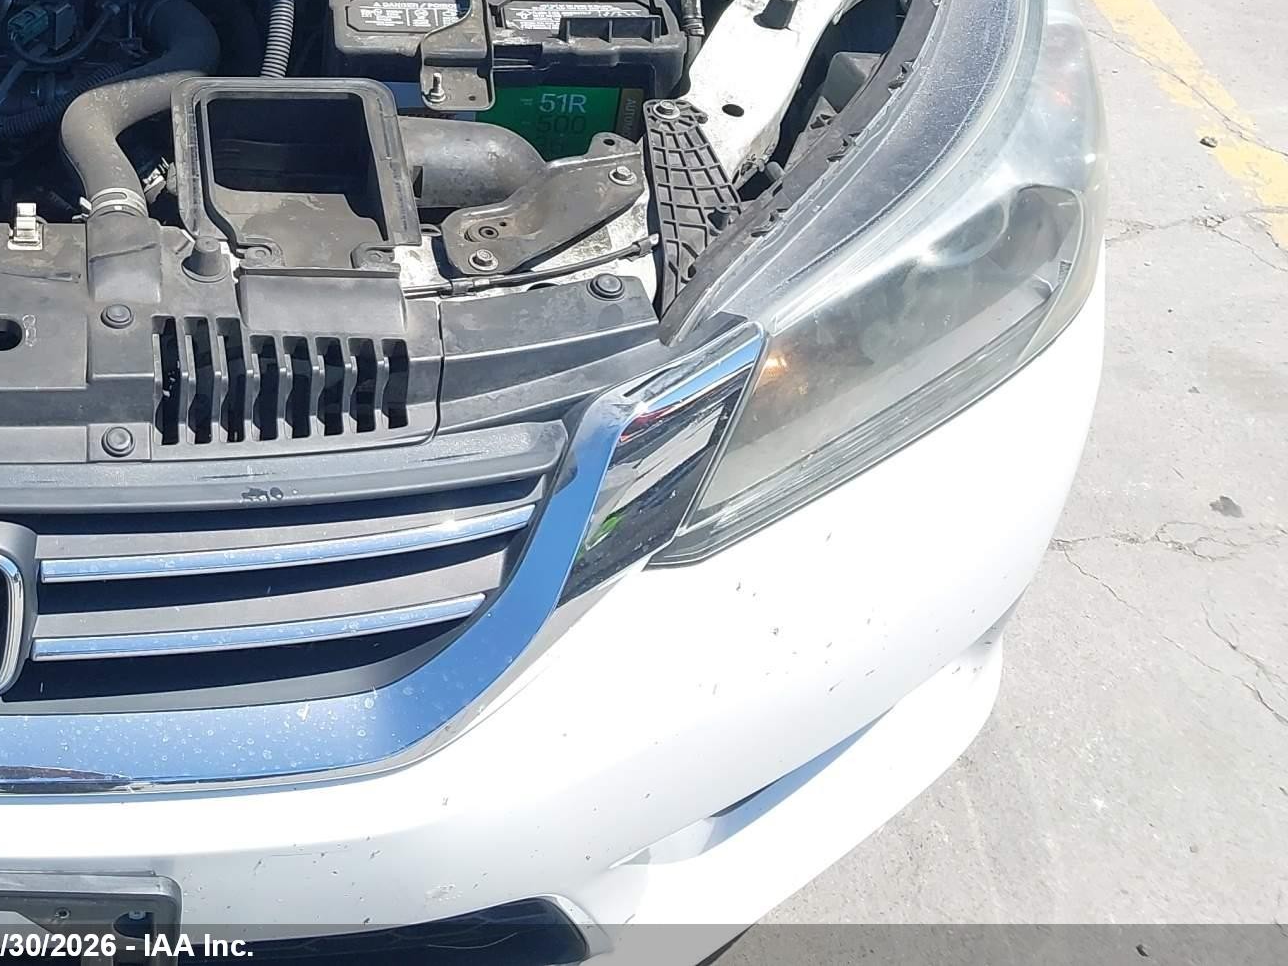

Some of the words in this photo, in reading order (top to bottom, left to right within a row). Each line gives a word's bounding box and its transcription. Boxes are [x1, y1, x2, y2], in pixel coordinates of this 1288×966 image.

[382, 1, 419, 9] DANGER
[538, 93, 587, 114] 51R
[536, 115, 587, 133] 500
